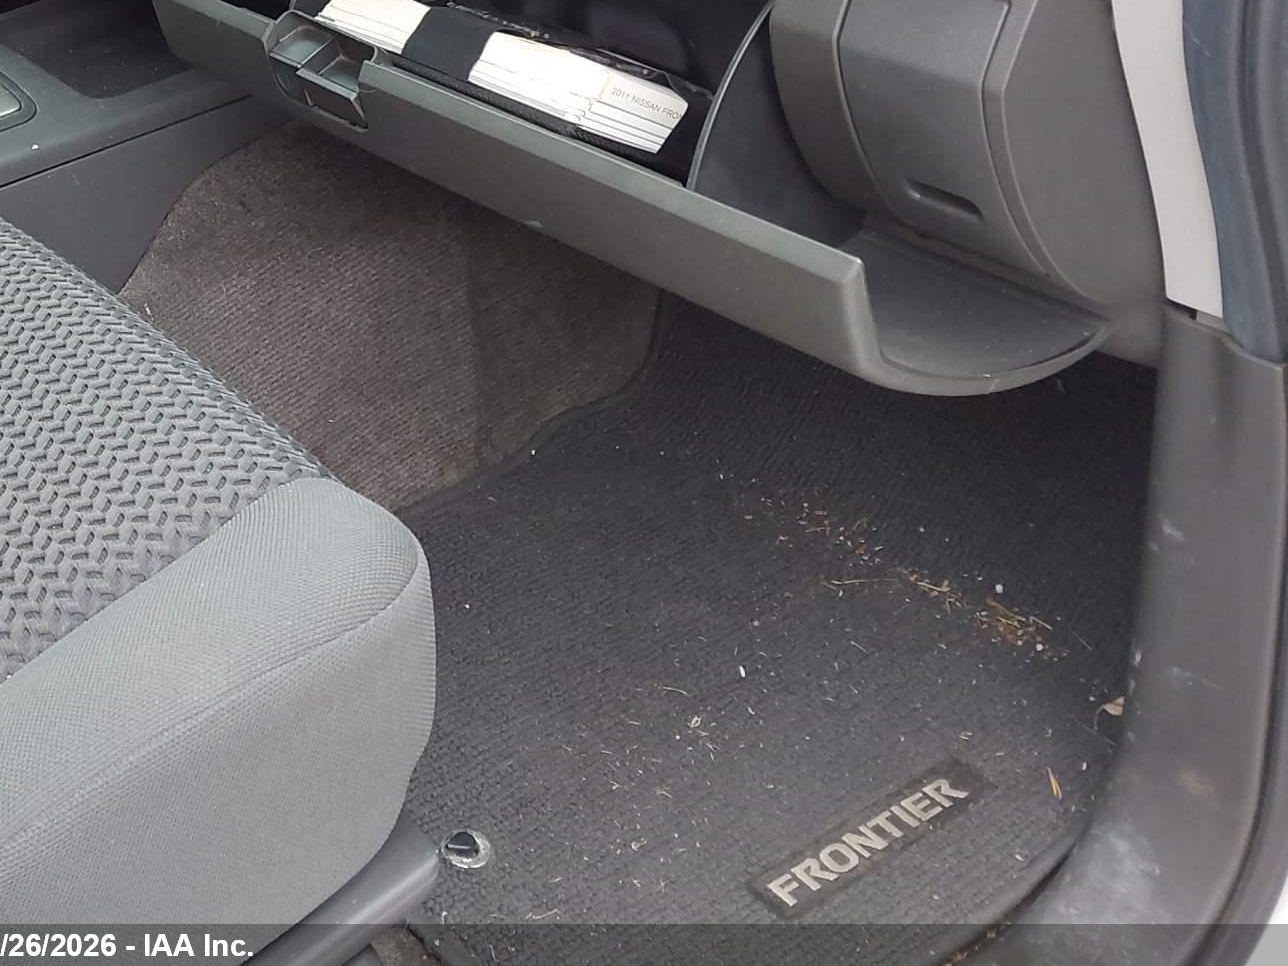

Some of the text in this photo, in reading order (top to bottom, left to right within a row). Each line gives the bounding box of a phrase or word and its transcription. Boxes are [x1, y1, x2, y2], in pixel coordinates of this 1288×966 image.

[610, 87, 630, 99] 2011
[631, 95, 662, 112] NISSAN
[767, 779, 969, 907] FRONTIER
